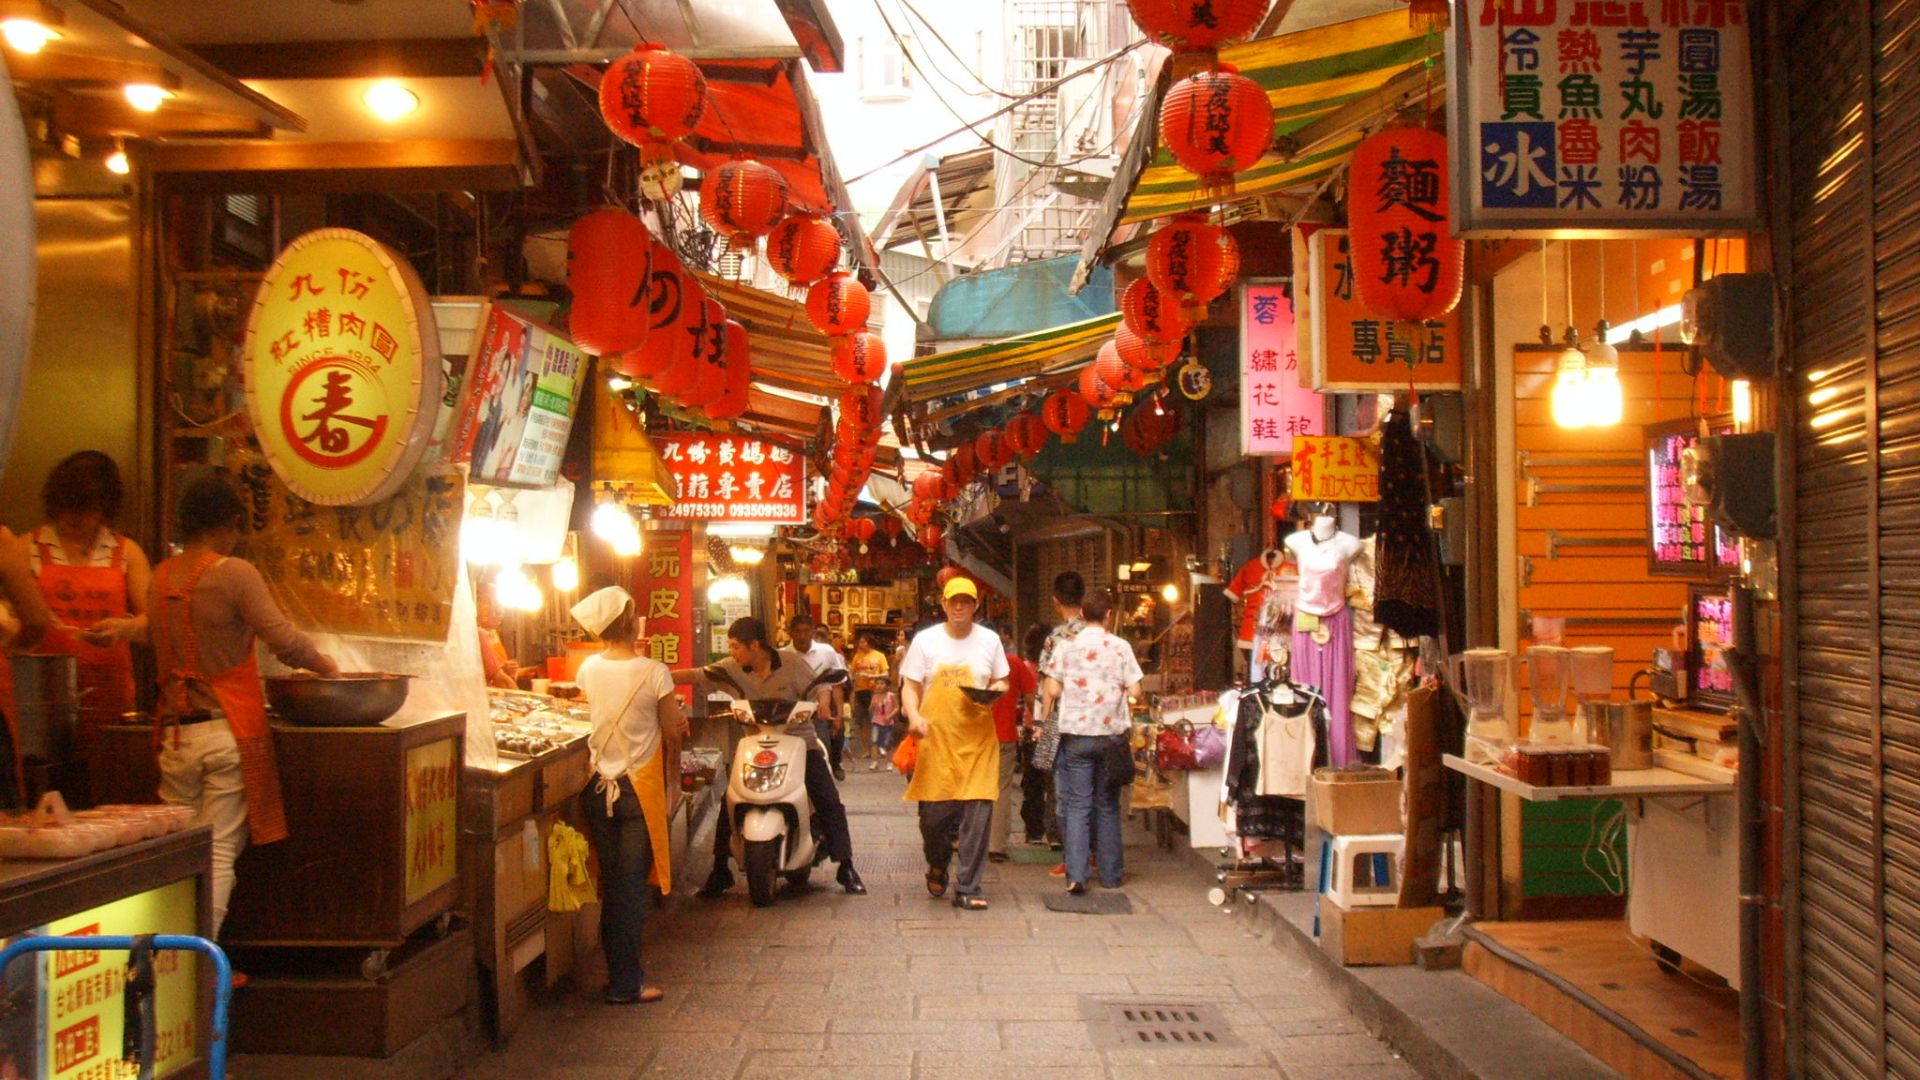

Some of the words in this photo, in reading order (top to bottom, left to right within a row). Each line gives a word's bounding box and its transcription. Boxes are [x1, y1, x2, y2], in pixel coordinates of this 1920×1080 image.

[1503, 27, 1720, 75] 冷熱芋圓
[1500, 73, 1723, 121] 貢魚丸湯
[1484, 131, 1557, 197] 冰
[1557, 118, 1723, 165] 魯肉飯
[1557, 164, 1723, 211] 米粉湯
[1376, 146, 1447, 295] 麵粥
[289, 267, 376, 301] 九份
[1253, 294, 1280, 325] 蓉
[287, 347, 335, 375] SINCE
[1250, 348, 1281, 441] 繡花鞋
[1294, 440, 1317, 498] 有
[1320, 440, 1379, 469] 手工皮
[669, 503, 725, 518] 24975330
[729, 503, 797, 518] 0935091336
[649, 533, 680, 664] 玩皮館
